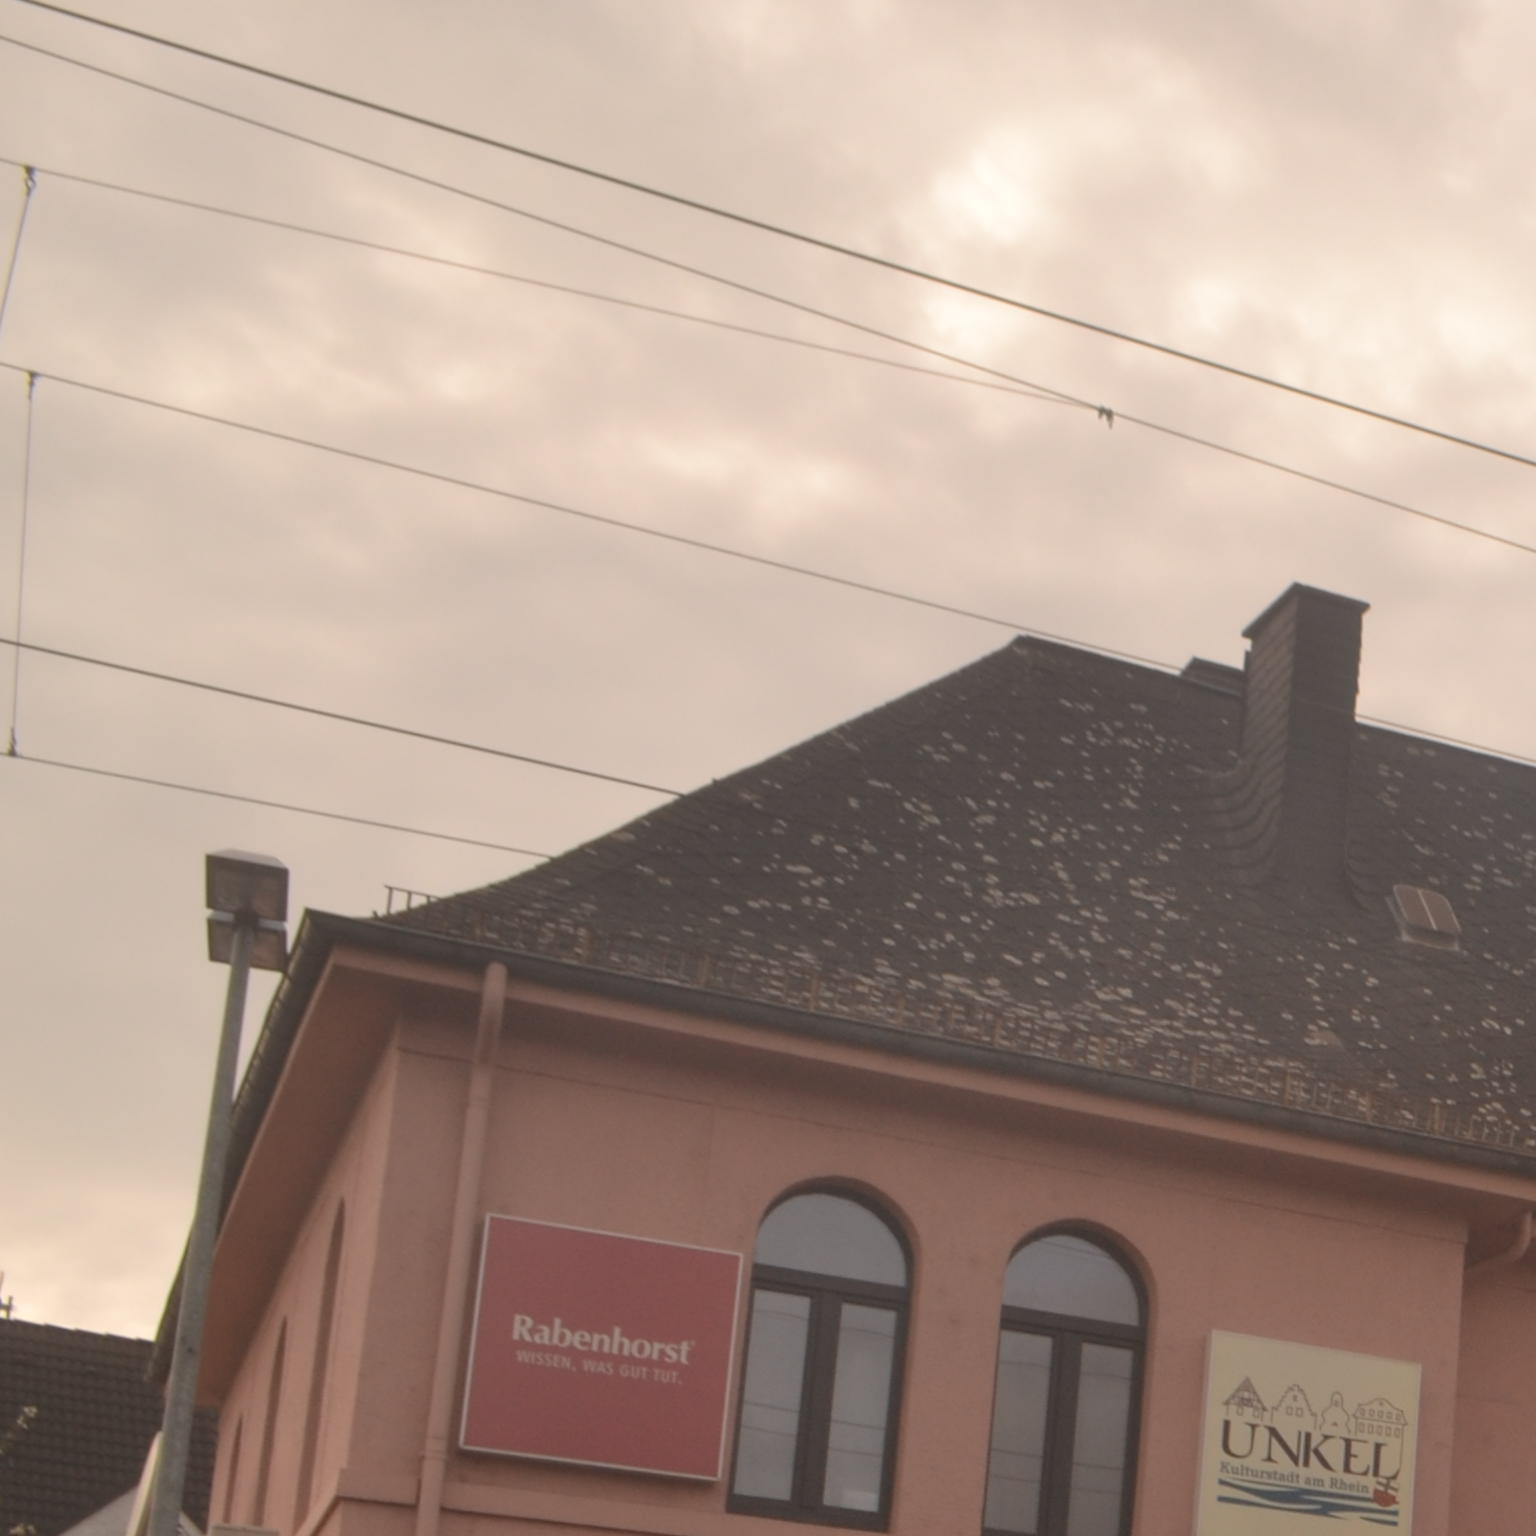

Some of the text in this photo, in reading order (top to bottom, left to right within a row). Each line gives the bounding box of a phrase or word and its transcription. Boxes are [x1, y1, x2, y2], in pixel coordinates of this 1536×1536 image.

[511, 1313, 691, 1365] Rabenhorst
[583, 1359, 613, 1376] WAS
[620, 1364, 650, 1380] GUT
[1220, 1419, 1402, 1481] UNKEL
[1220, 1461, 1370, 1494] Kulturstadt am Rhein
